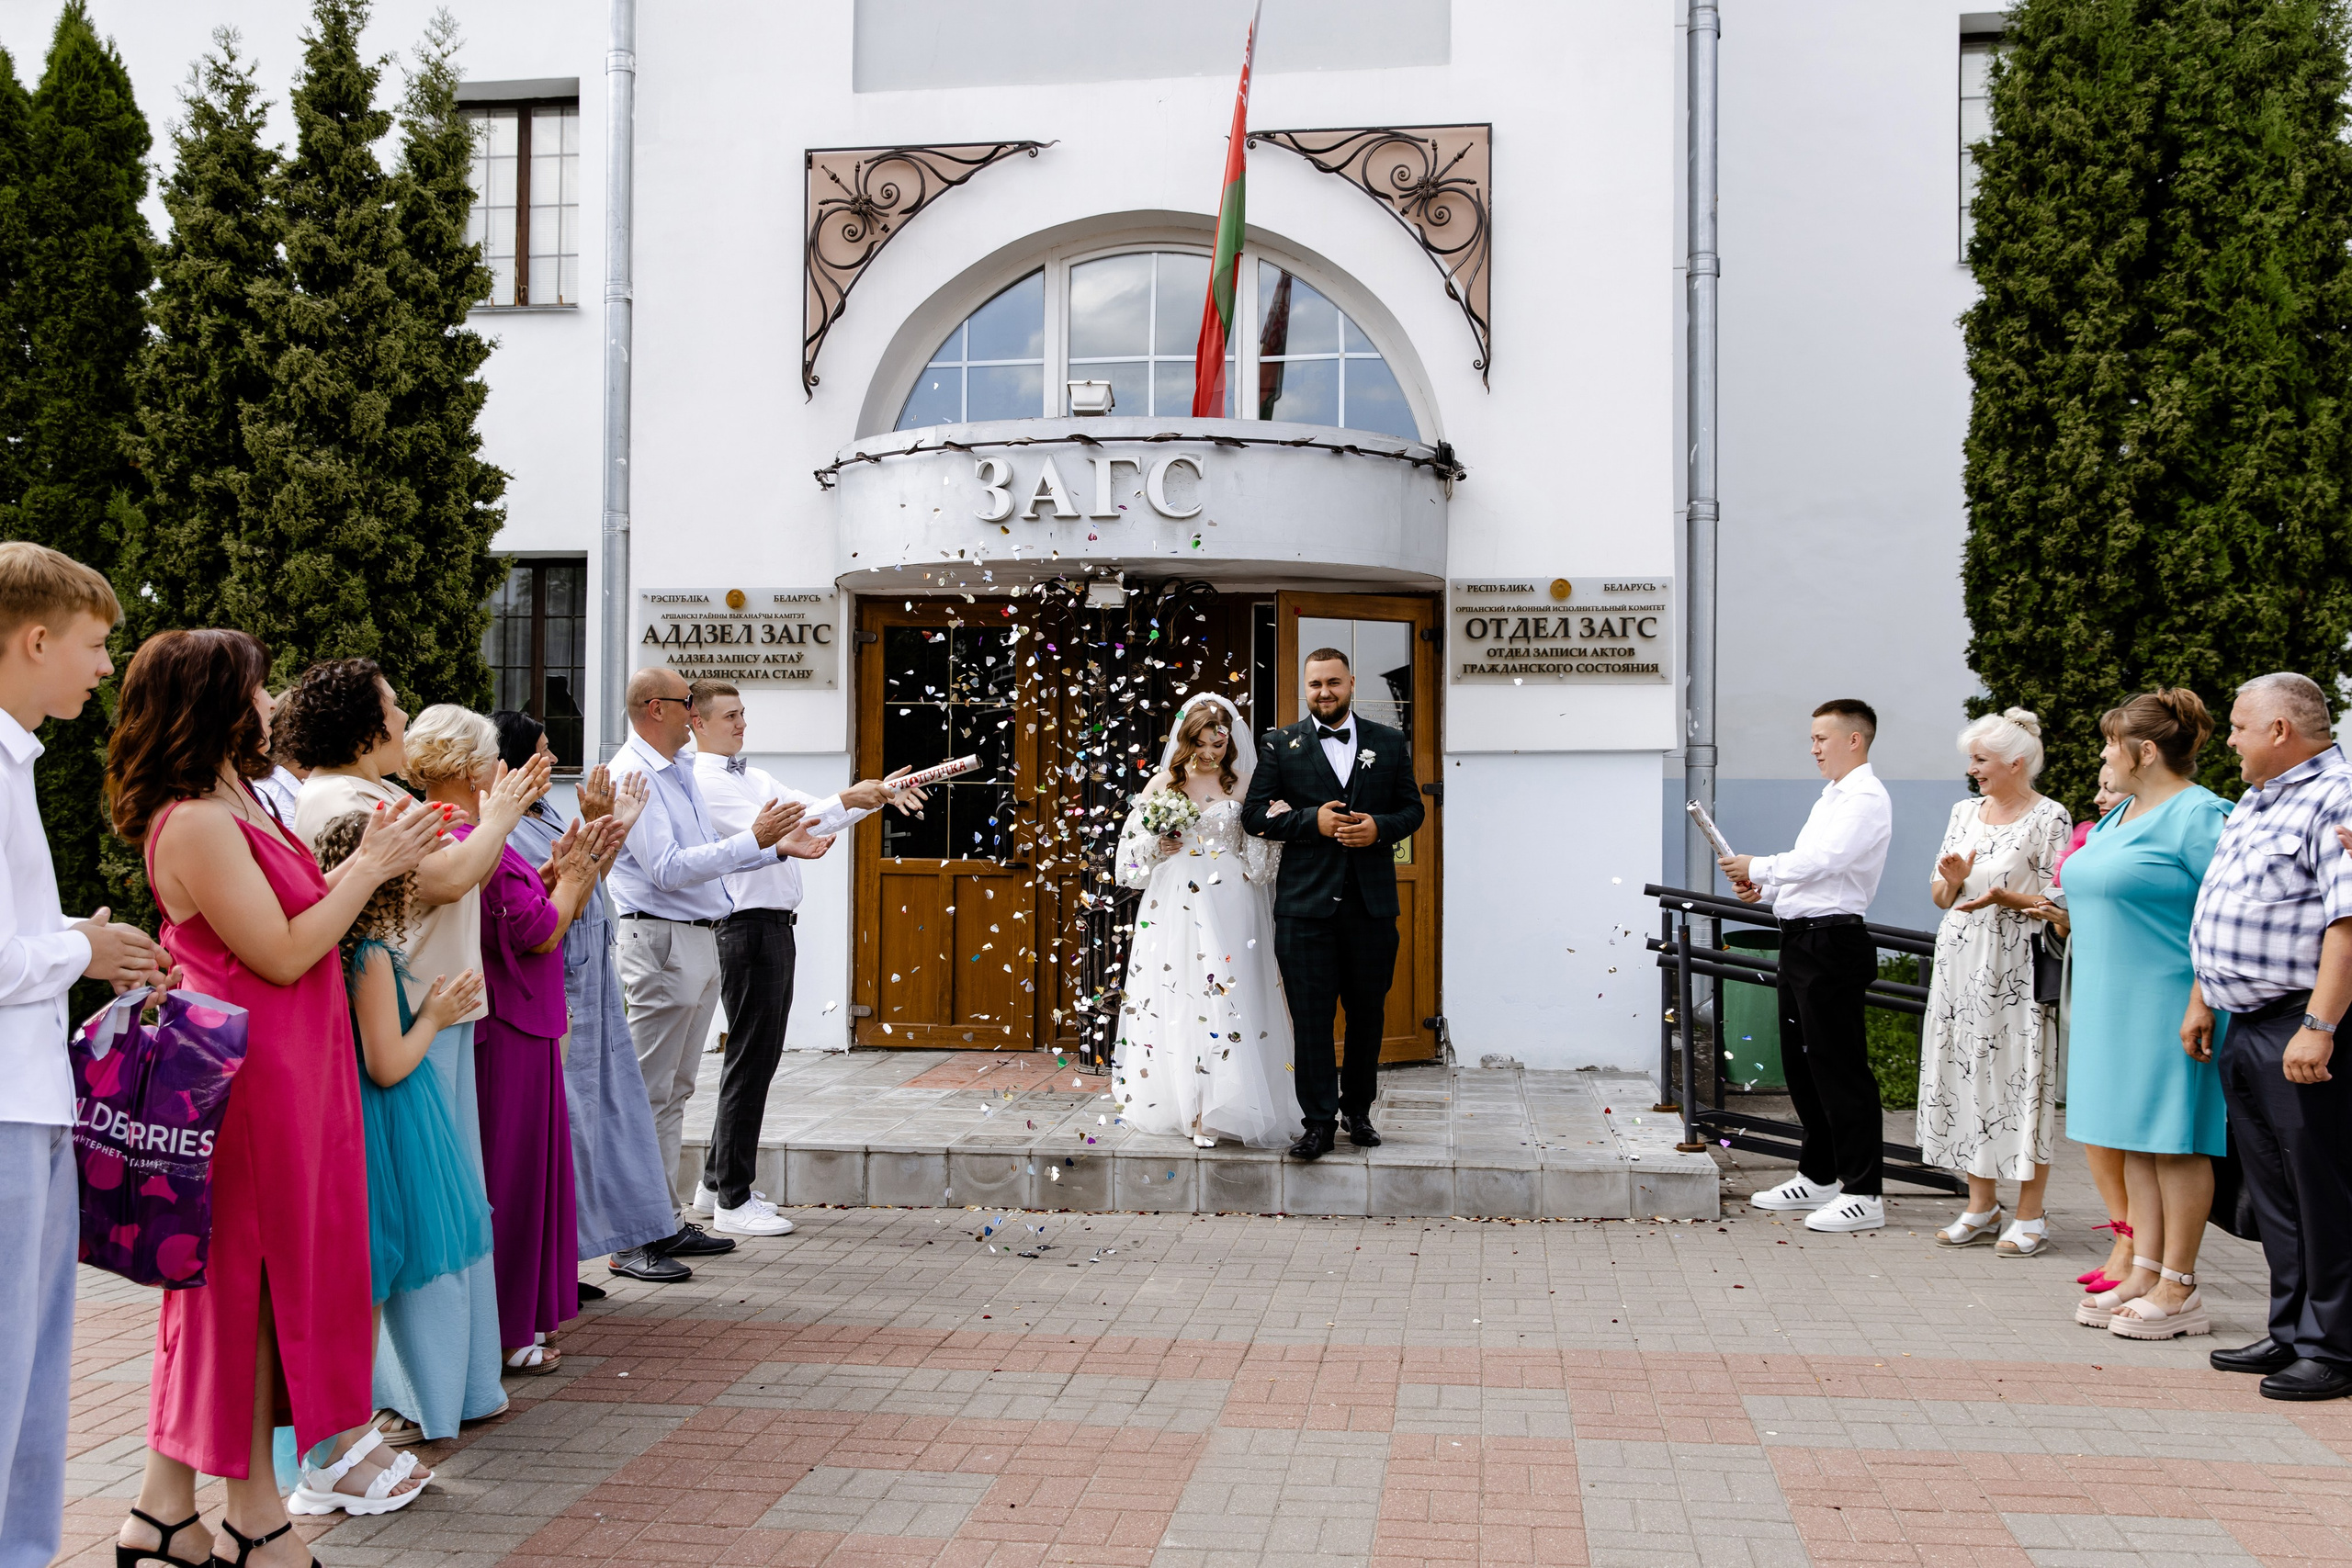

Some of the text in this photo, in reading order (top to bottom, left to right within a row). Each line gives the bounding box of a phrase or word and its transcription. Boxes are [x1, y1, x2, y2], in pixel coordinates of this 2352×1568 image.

[973, 454, 1204, 522] ЗАГС
[1467, 583, 1657, 592] РЕСПУБЛИКА БЕЛАРУСЬ
[650, 594, 820, 603] РЭСПУБЛІКА БЕЛАРУСЬ
[1552, 604, 1627, 613] ИСПОЛНИТЕЛЬНЫЙ
[641, 624, 831, 649] АДДЗЕЛ ЗАГС
[1465, 616, 1657, 645] ОТДЕЛ ЗАГС
[666, 651, 804, 665] АДДЗЕЛ ЗАПІСУ АКТАЎ
[1487, 647, 1635, 660] ОТДЕЛ ЗАПИСИ АКТОВ
[673, 669, 814, 679] МАДЗЯНСКАГА СТАНУ
[1463, 663, 1659, 675] ГРАЖДАНСКОГО СОСТОЯНИЯ
